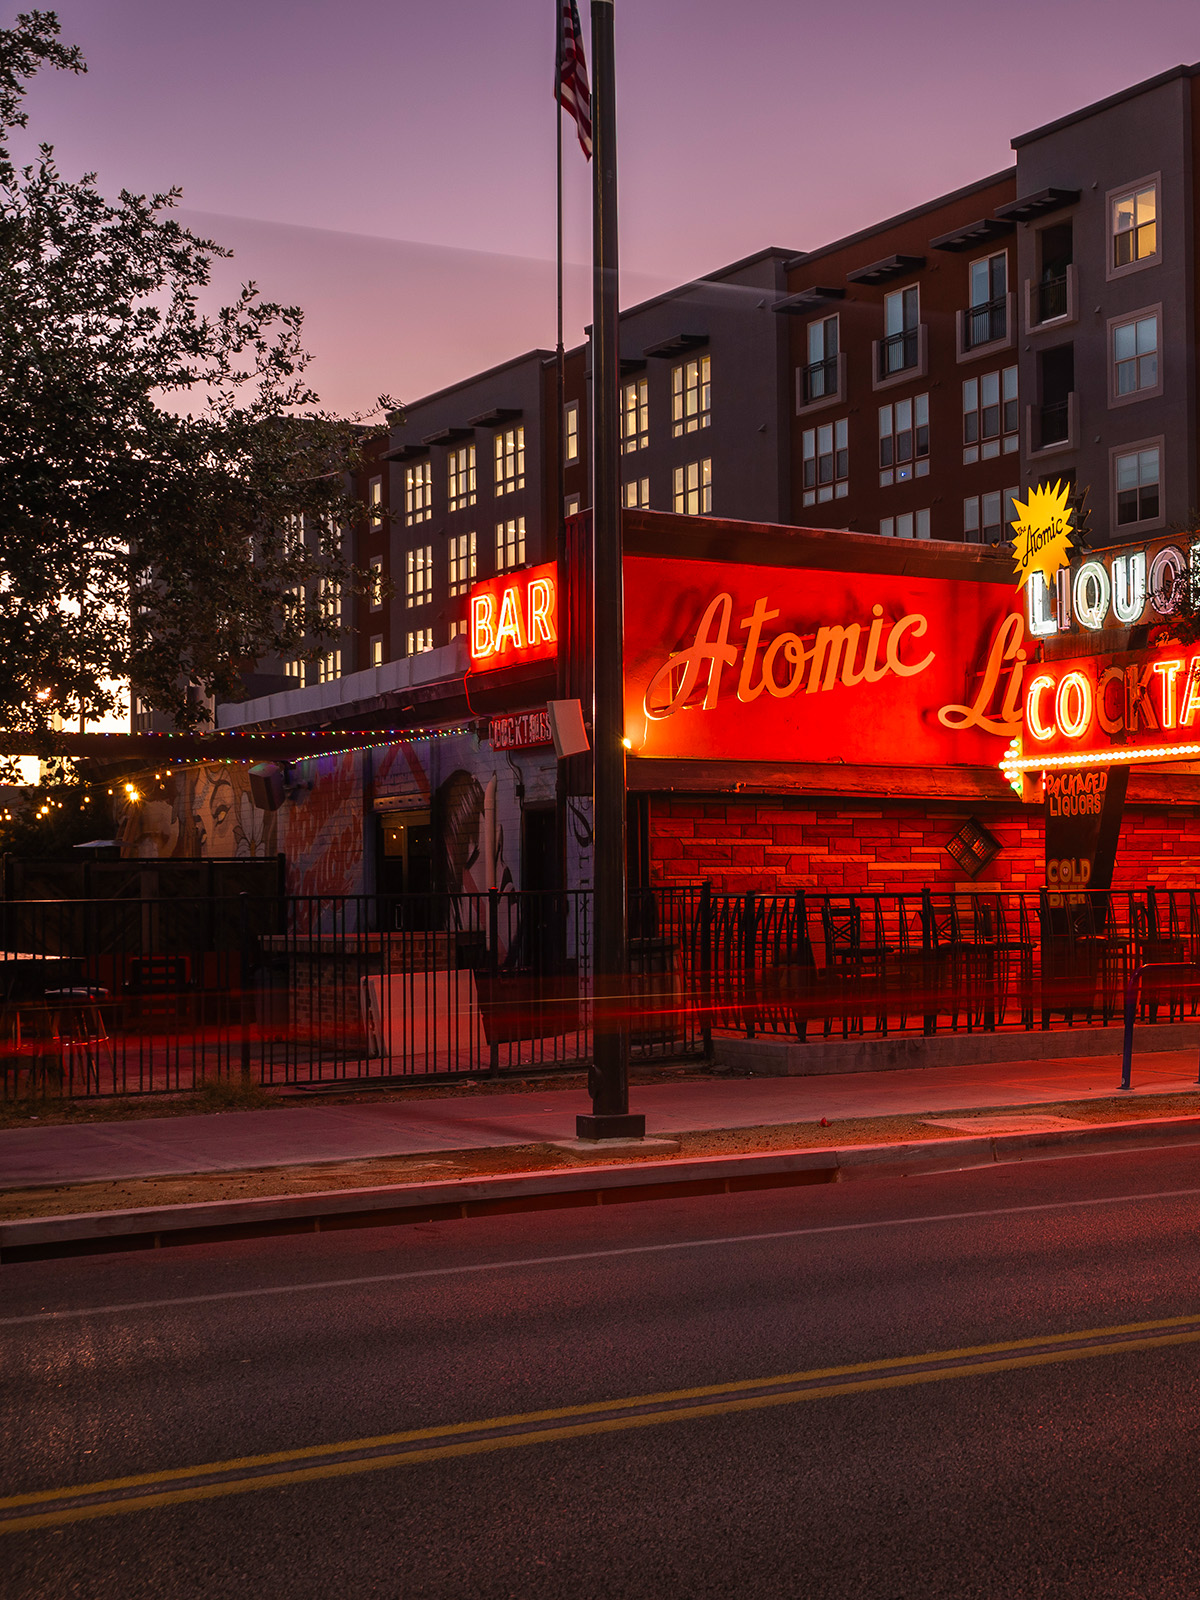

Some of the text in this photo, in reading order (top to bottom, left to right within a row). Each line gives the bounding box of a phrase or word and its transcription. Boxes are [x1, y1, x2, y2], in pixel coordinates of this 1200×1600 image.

[1022, 516, 1063, 567] Atomic
[471, 578, 558, 658] BAR
[643, 592, 936, 721] Atomic
[1046, 771, 1108, 799] PACKAGED
[1050, 793, 1101, 817] LIQUORS
[1047, 858, 1091, 884] COLD
